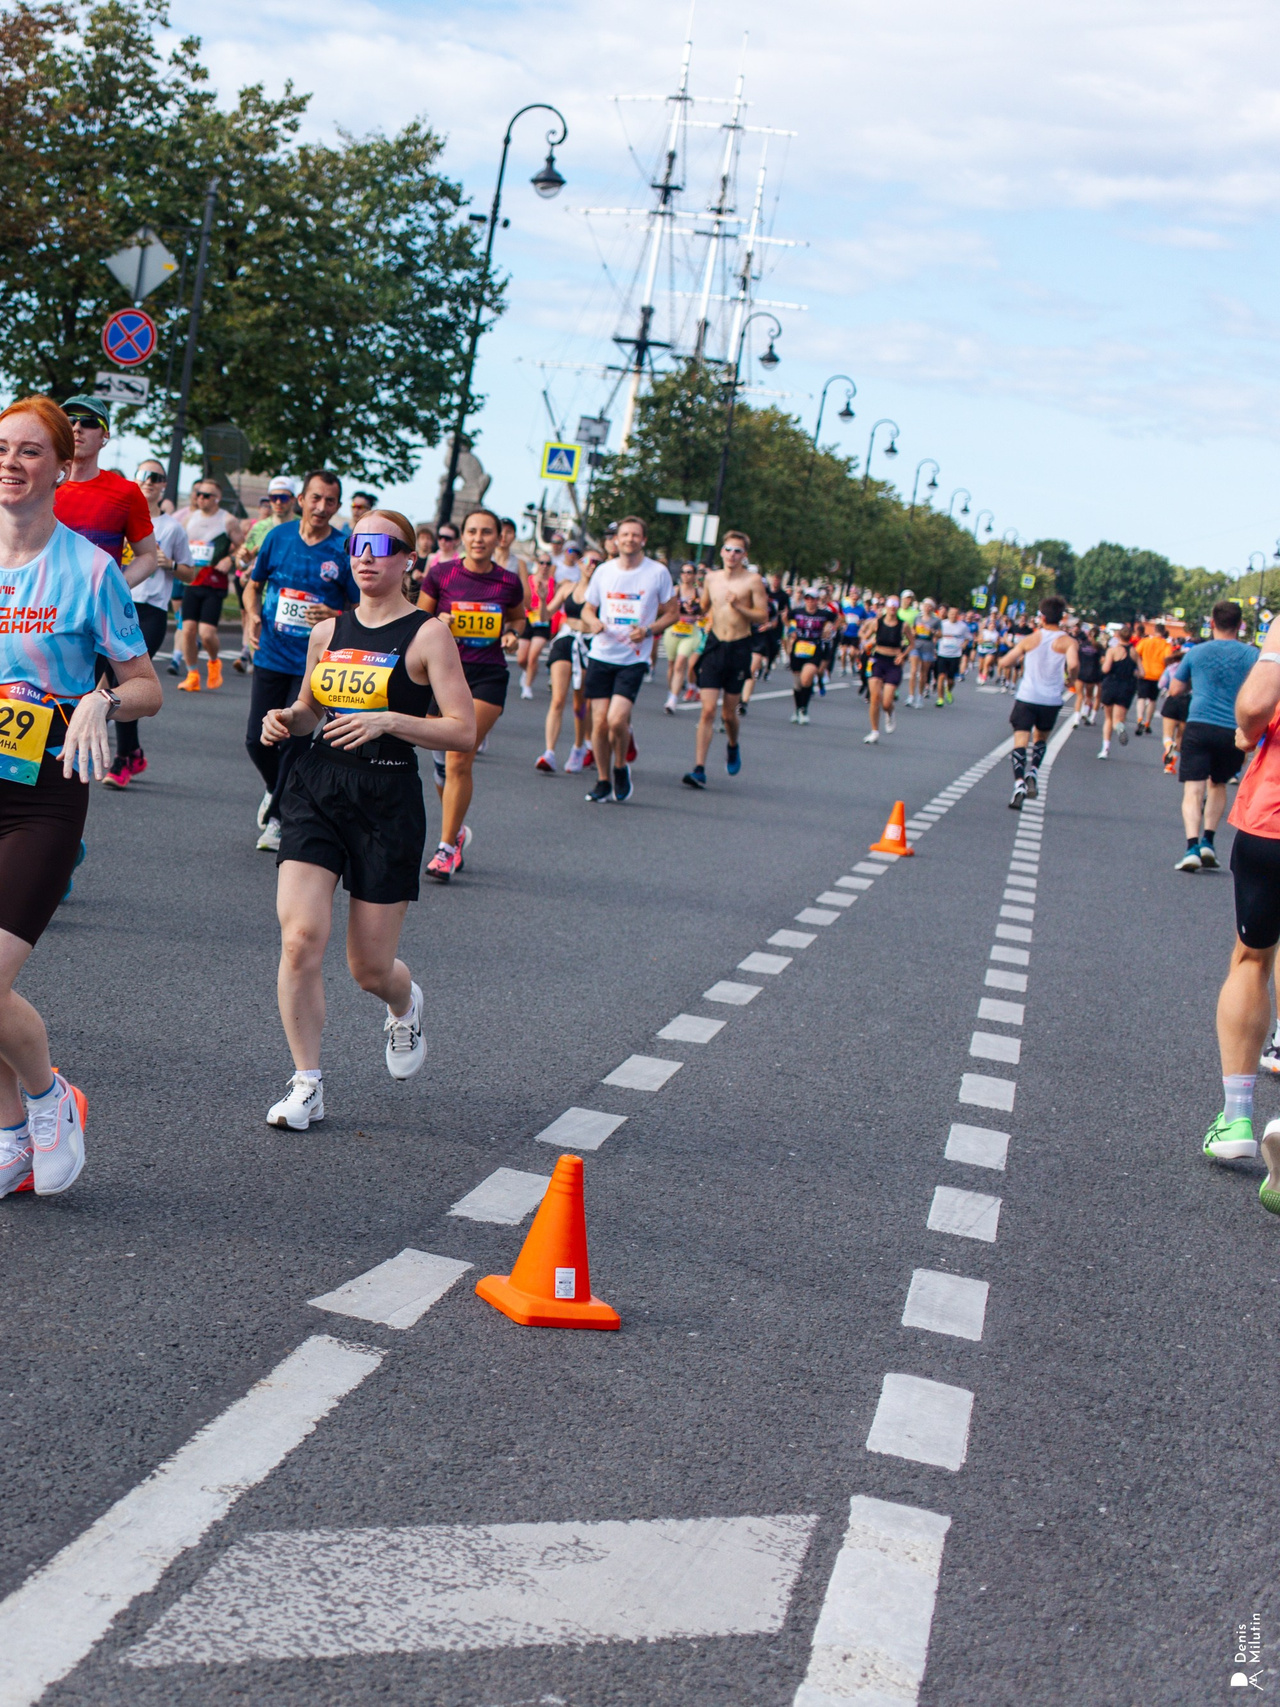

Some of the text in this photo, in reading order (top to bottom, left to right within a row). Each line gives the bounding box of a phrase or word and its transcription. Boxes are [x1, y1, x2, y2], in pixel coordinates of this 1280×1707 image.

[282, 602, 308, 618] 383
[457, 615, 495, 630] 5118
[320, 668, 376, 695] 5156
[10, 685, 41, 701] 21,1 КМ
[328, 695, 365, 704] СВЕТЛАНА
